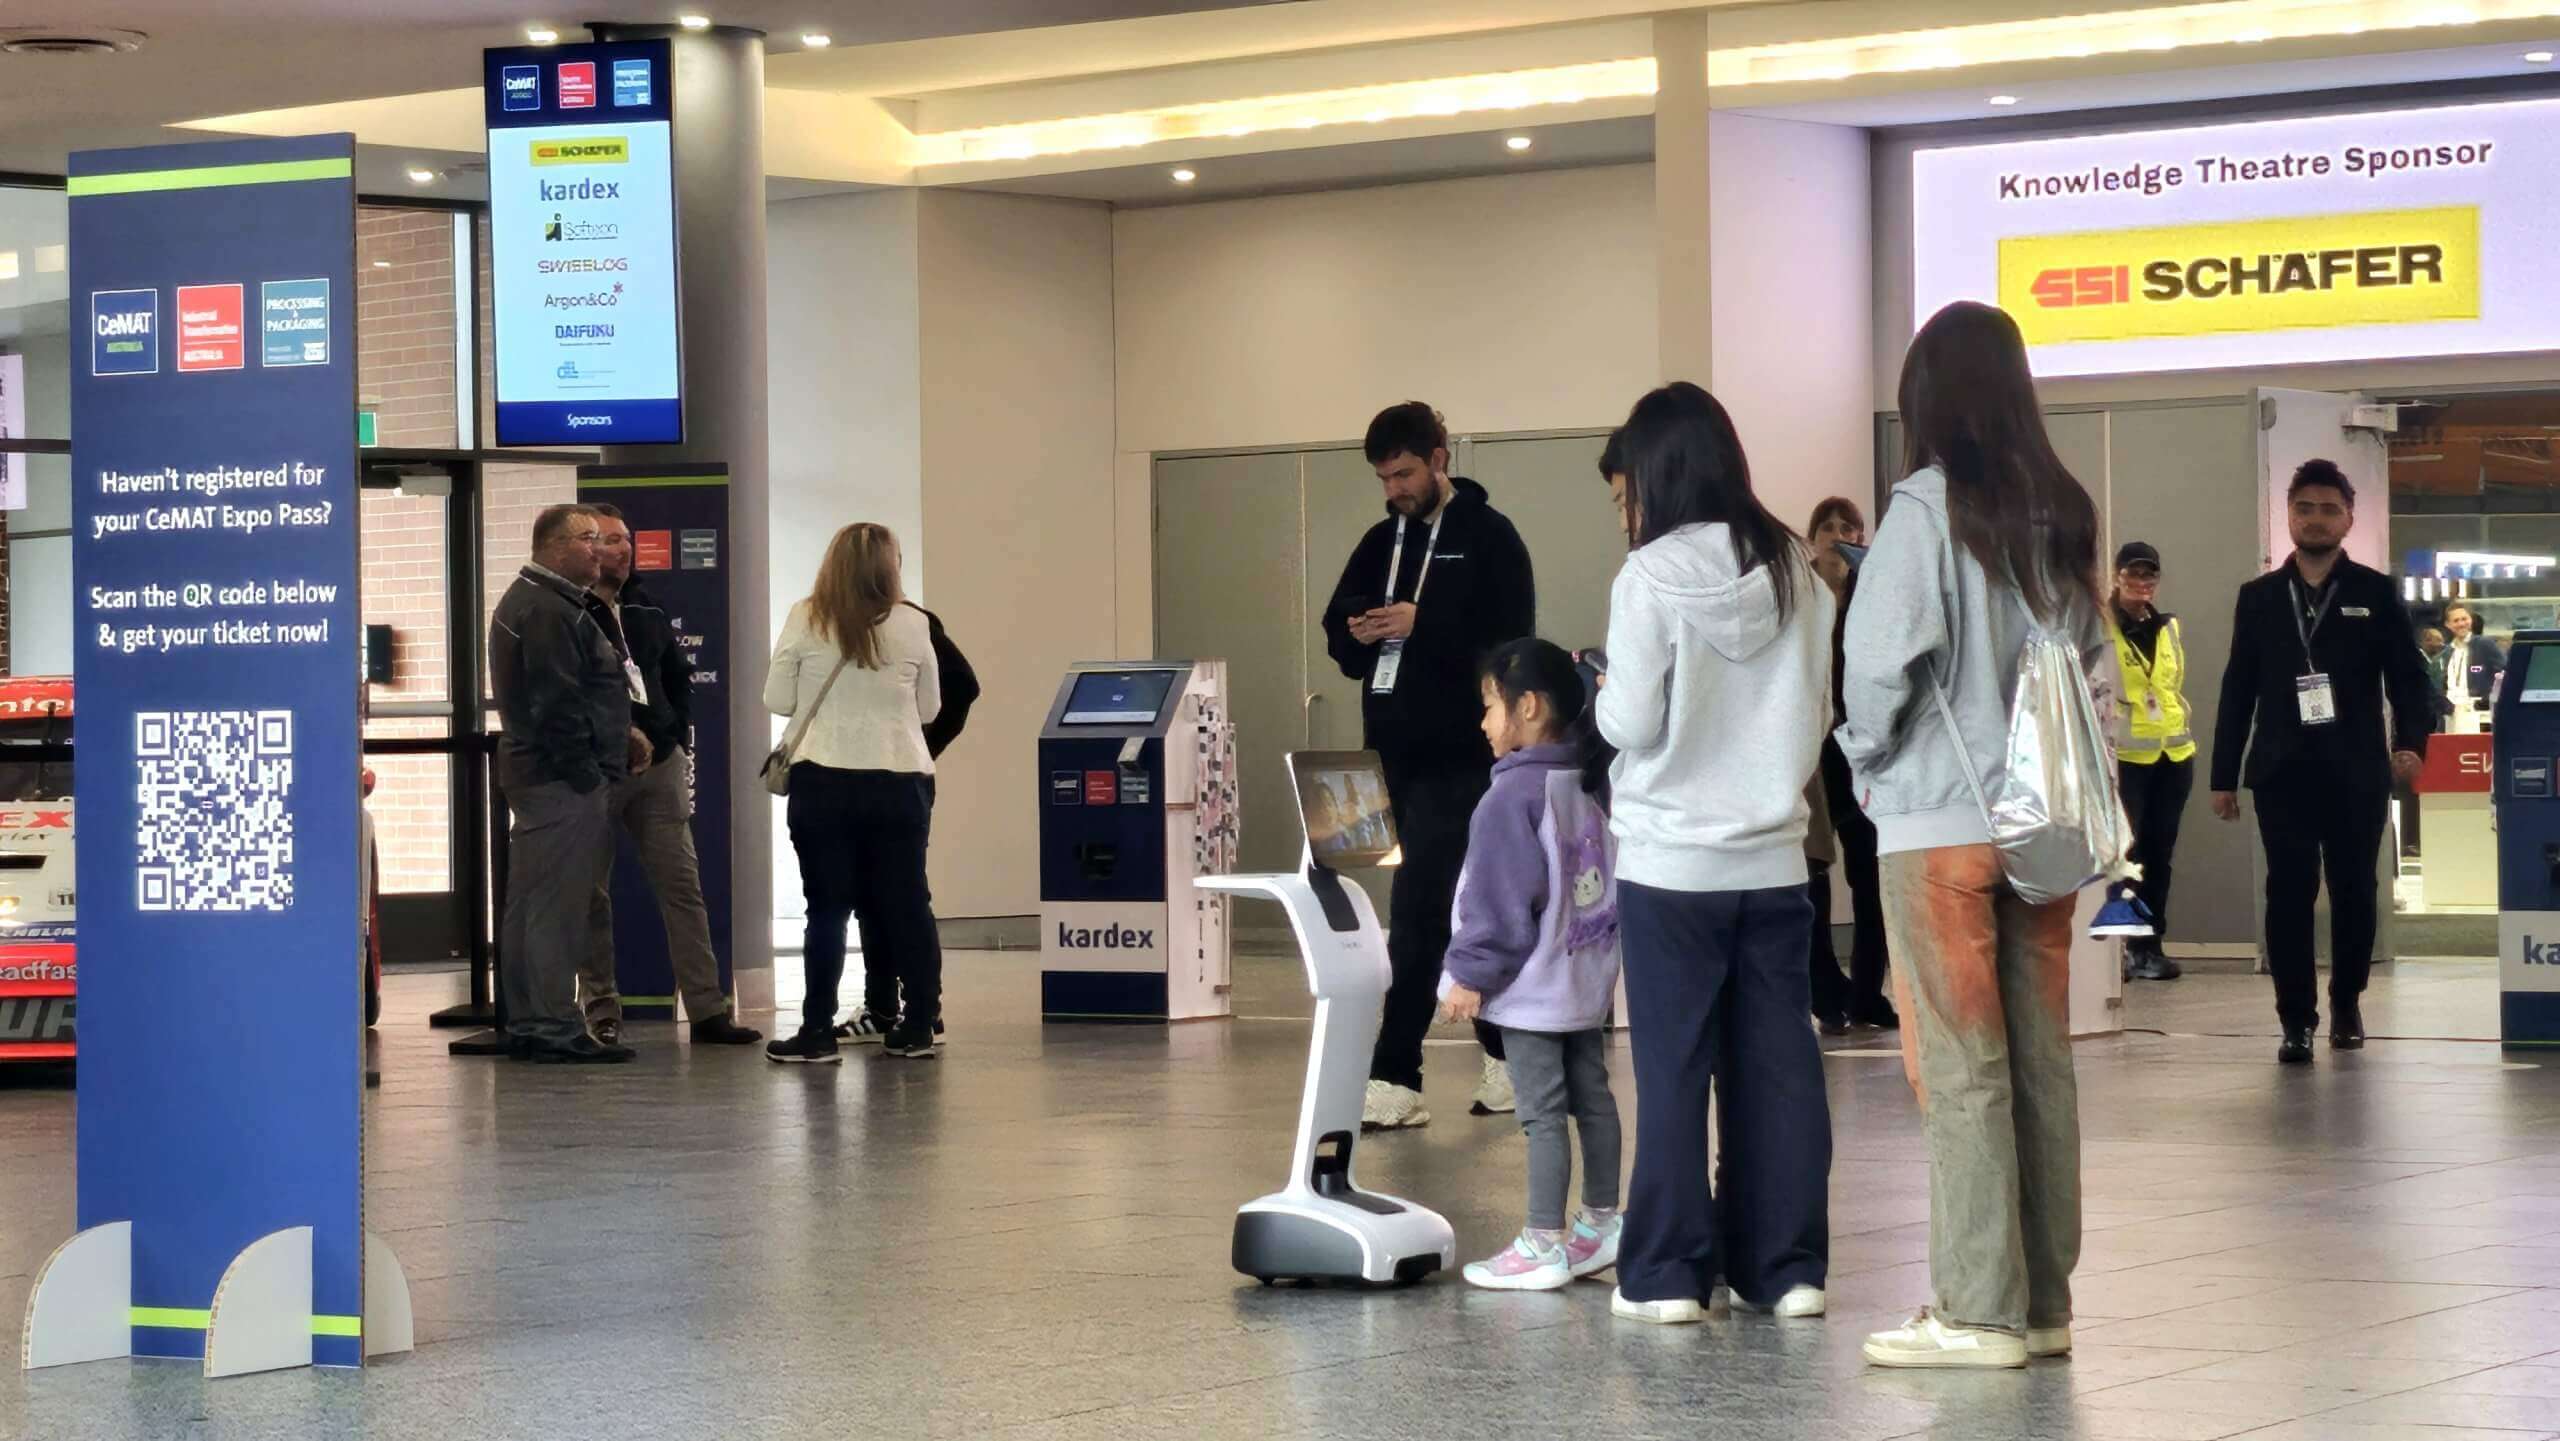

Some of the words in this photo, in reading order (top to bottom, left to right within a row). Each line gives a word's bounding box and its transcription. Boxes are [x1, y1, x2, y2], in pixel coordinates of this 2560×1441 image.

[2000, 162, 2183, 200] Knowledge
[2196, 150, 2330, 184] Theatre
[2344, 138, 2493, 177] Sponsor
[540, 177, 619, 201] kardex
[2029, 265, 2129, 307] SSI
[2142, 244, 2443, 301] SCHÄFER
[544, 293, 617, 310] Argon&Co
[97, 313, 153, 336] CeMAT
[567, 413, 613, 428] Sponsors
[102, 467, 180, 493] Haven't
[185, 463, 288, 496] registered
[293, 462, 325, 486] for
[92, 513, 139, 539] your
[145, 506, 216, 531] CeMAT
[223, 505, 272, 534] Expo
[279, 501, 332, 526] Pass?
[91, 587, 137, 609] Scan
[142, 583, 177, 607] the
[183, 583, 213, 608] QR
[219, 581, 267, 605] code
[273, 579, 337, 604] below
[99, 623, 116, 647] &
[123, 624, 156, 653] get
[161, 626, 208, 653] your
[213, 619, 271, 644] ticket
[276, 618, 328, 643] now!
[1059, 921, 1154, 949] kardex
